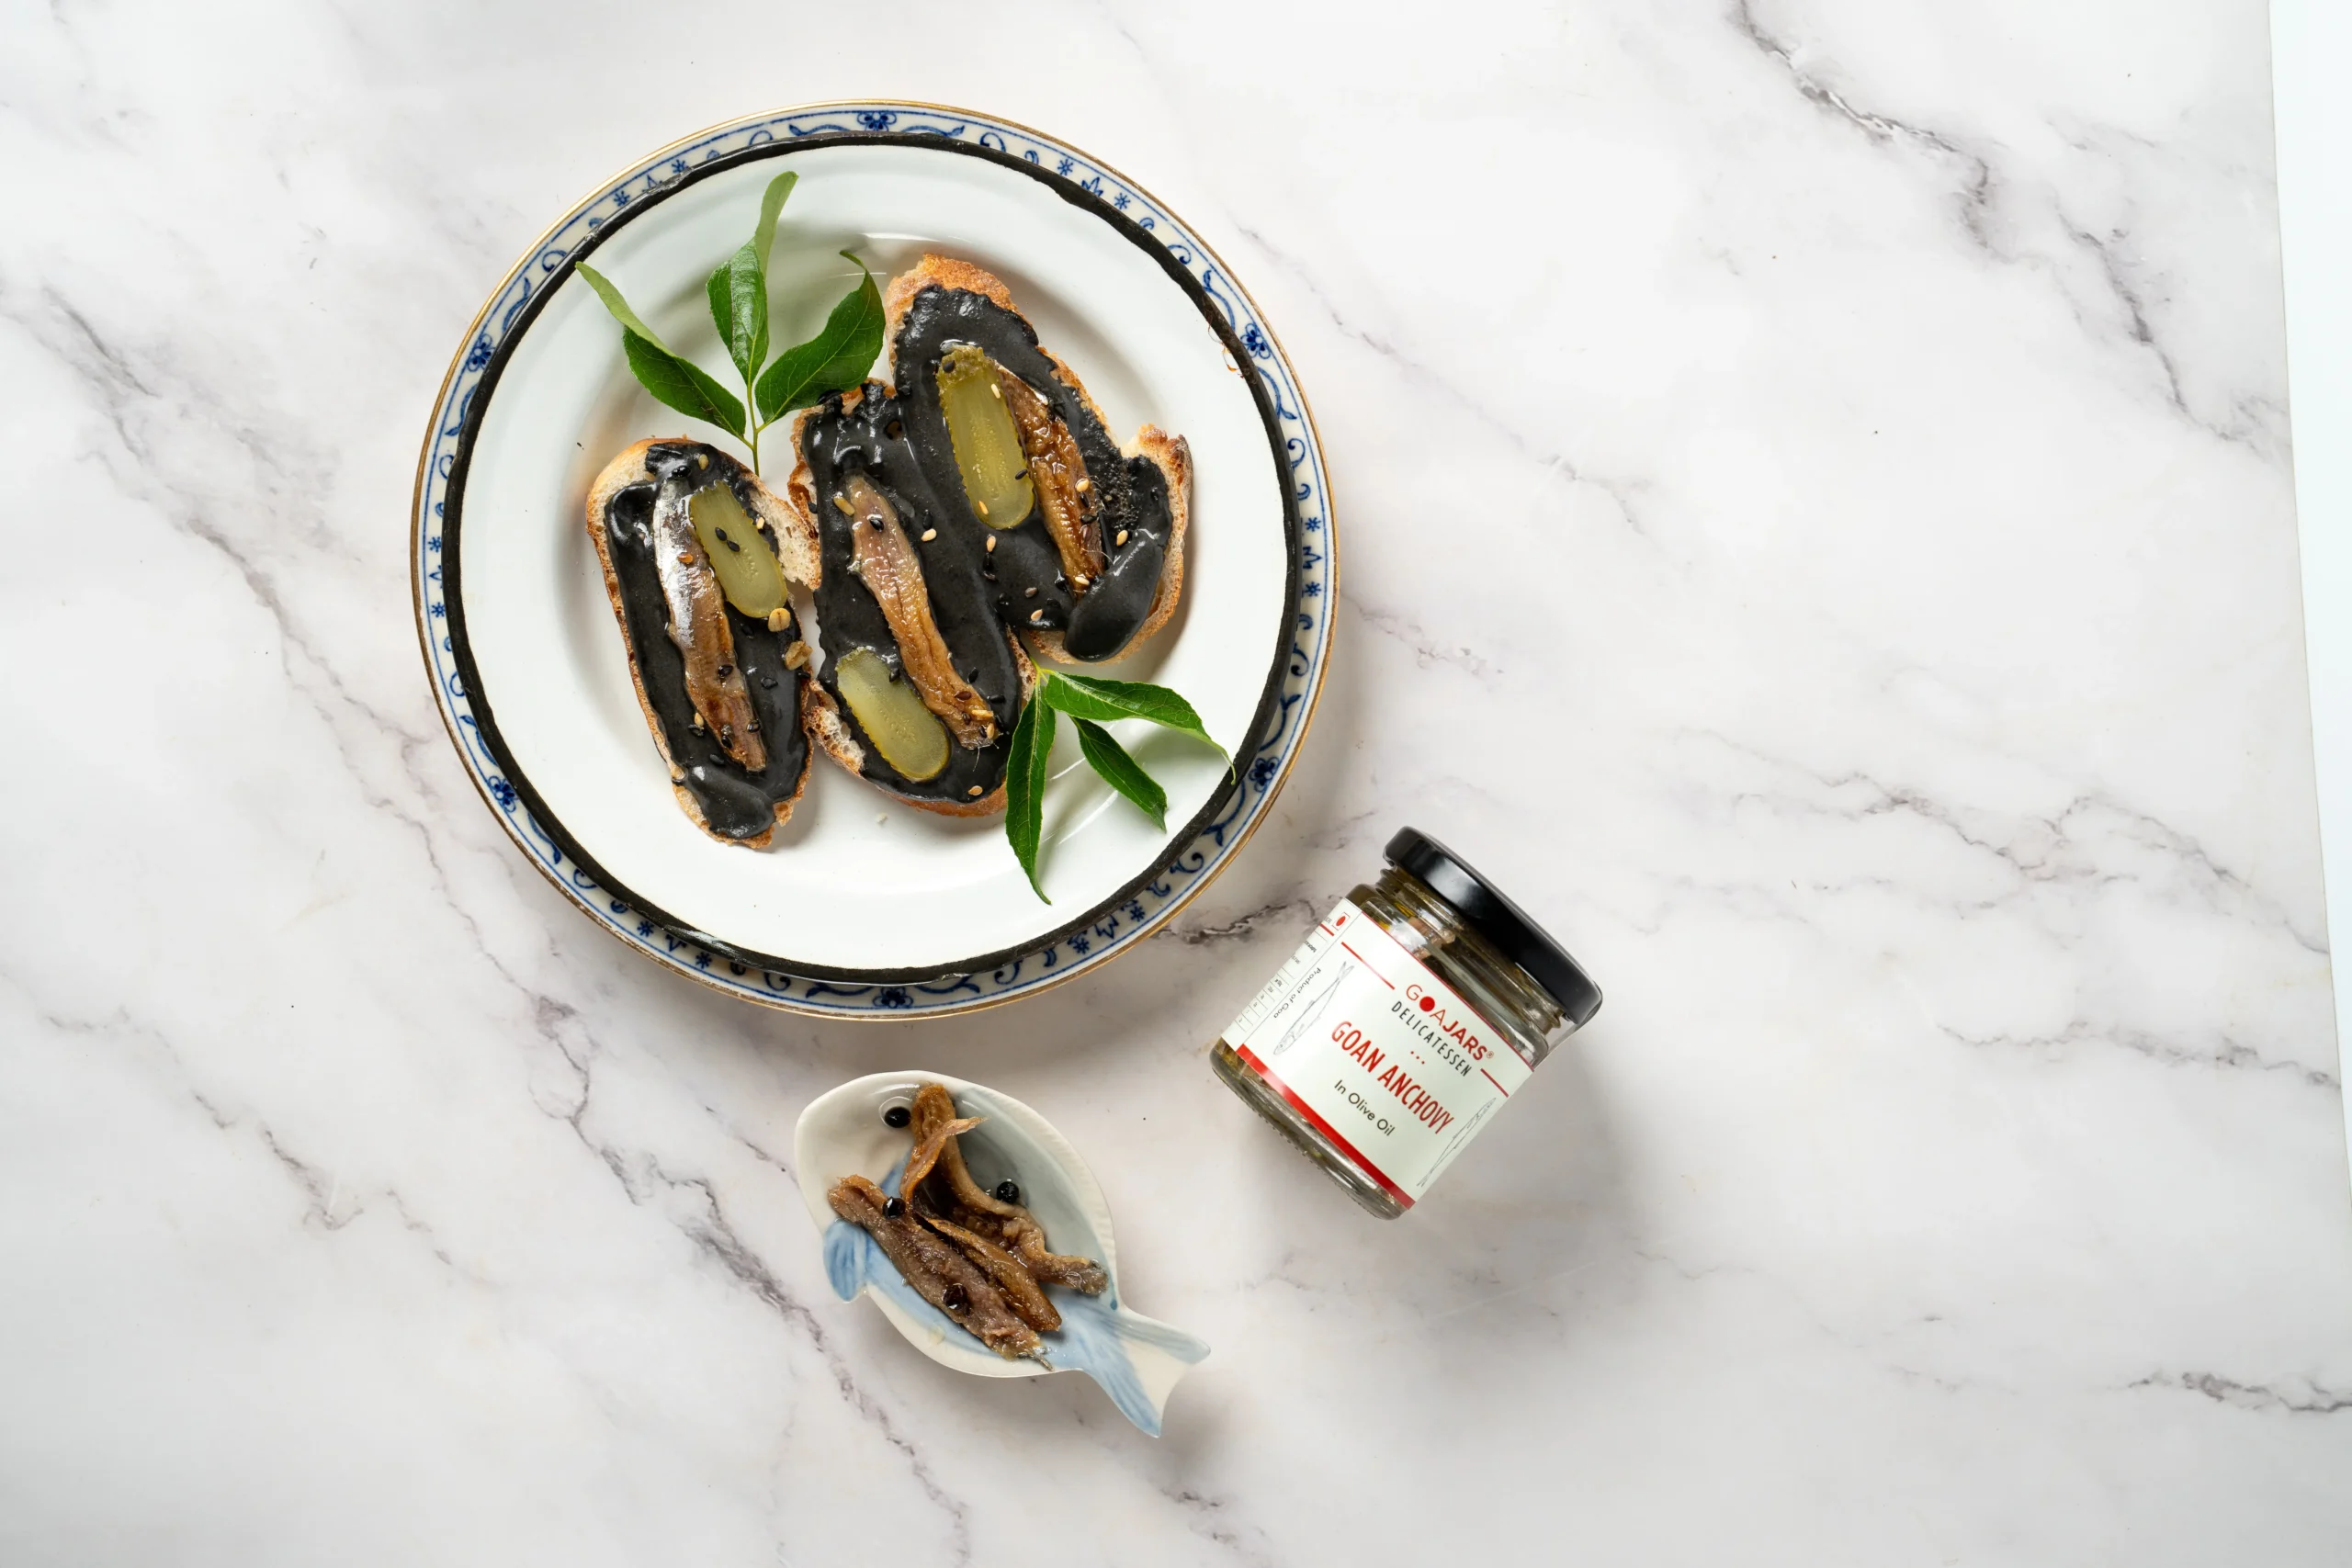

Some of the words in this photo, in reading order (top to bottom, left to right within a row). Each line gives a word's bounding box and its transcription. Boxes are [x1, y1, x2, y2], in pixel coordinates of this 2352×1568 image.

[1289, 993, 1296, 1003] of
[1296, 967, 1321, 994] Product
[1273, 1002, 1289, 1019] Goa
[1391, 1000, 1472, 1077] DELICATESSEN
[1331, 1021, 1385, 1073] GOAN
[1377, 1065, 1454, 1134] ANCHOVY
[1334, 1079, 1347, 1094] In
[1348, 1092, 1375, 1121] Olive
[1376, 1119, 1396, 1136] Oil
